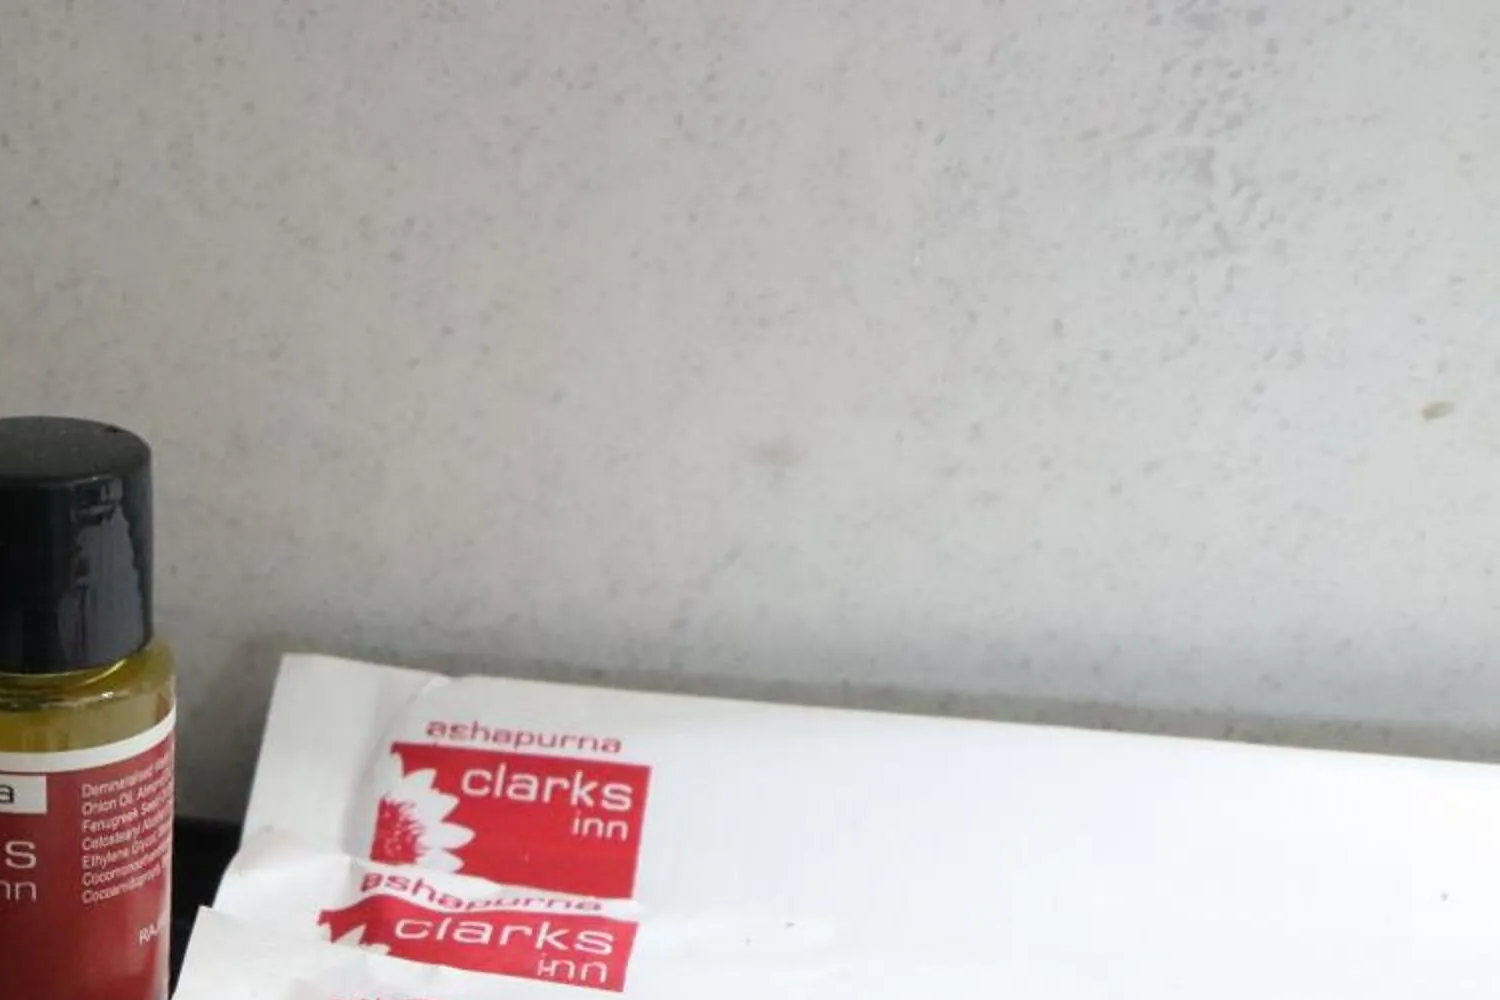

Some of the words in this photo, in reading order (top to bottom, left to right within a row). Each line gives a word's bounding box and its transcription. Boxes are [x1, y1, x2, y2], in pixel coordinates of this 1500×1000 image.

[426, 720, 622, 754] ashapurna
[461, 763, 633, 812] clarks
[572, 809, 629, 842] inn
[360, 872, 602, 912] ashapurna
[394, 917, 615, 955] clarks
[537, 952, 608, 984] inn
